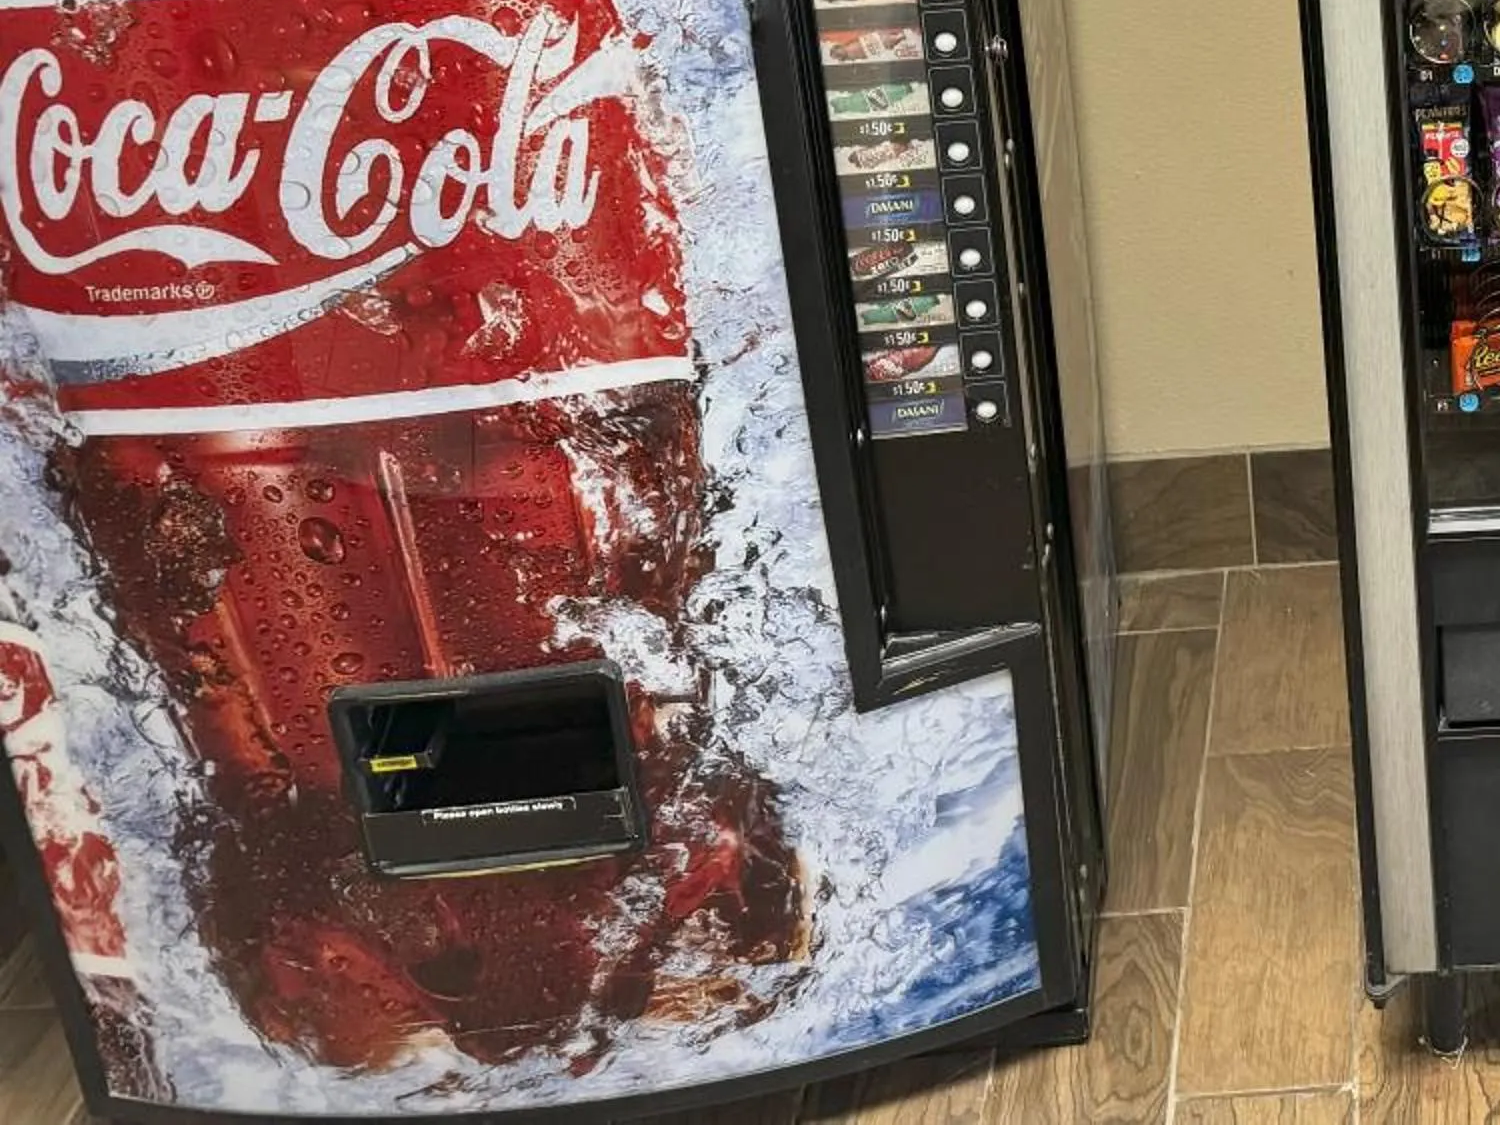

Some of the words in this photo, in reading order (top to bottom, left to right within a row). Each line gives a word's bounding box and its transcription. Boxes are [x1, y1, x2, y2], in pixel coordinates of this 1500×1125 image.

[434, 809, 466, 820] Please
[469, 807, 494, 818] open
[495, 804, 530, 815] bottles
[531, 801, 564, 812] slowly
